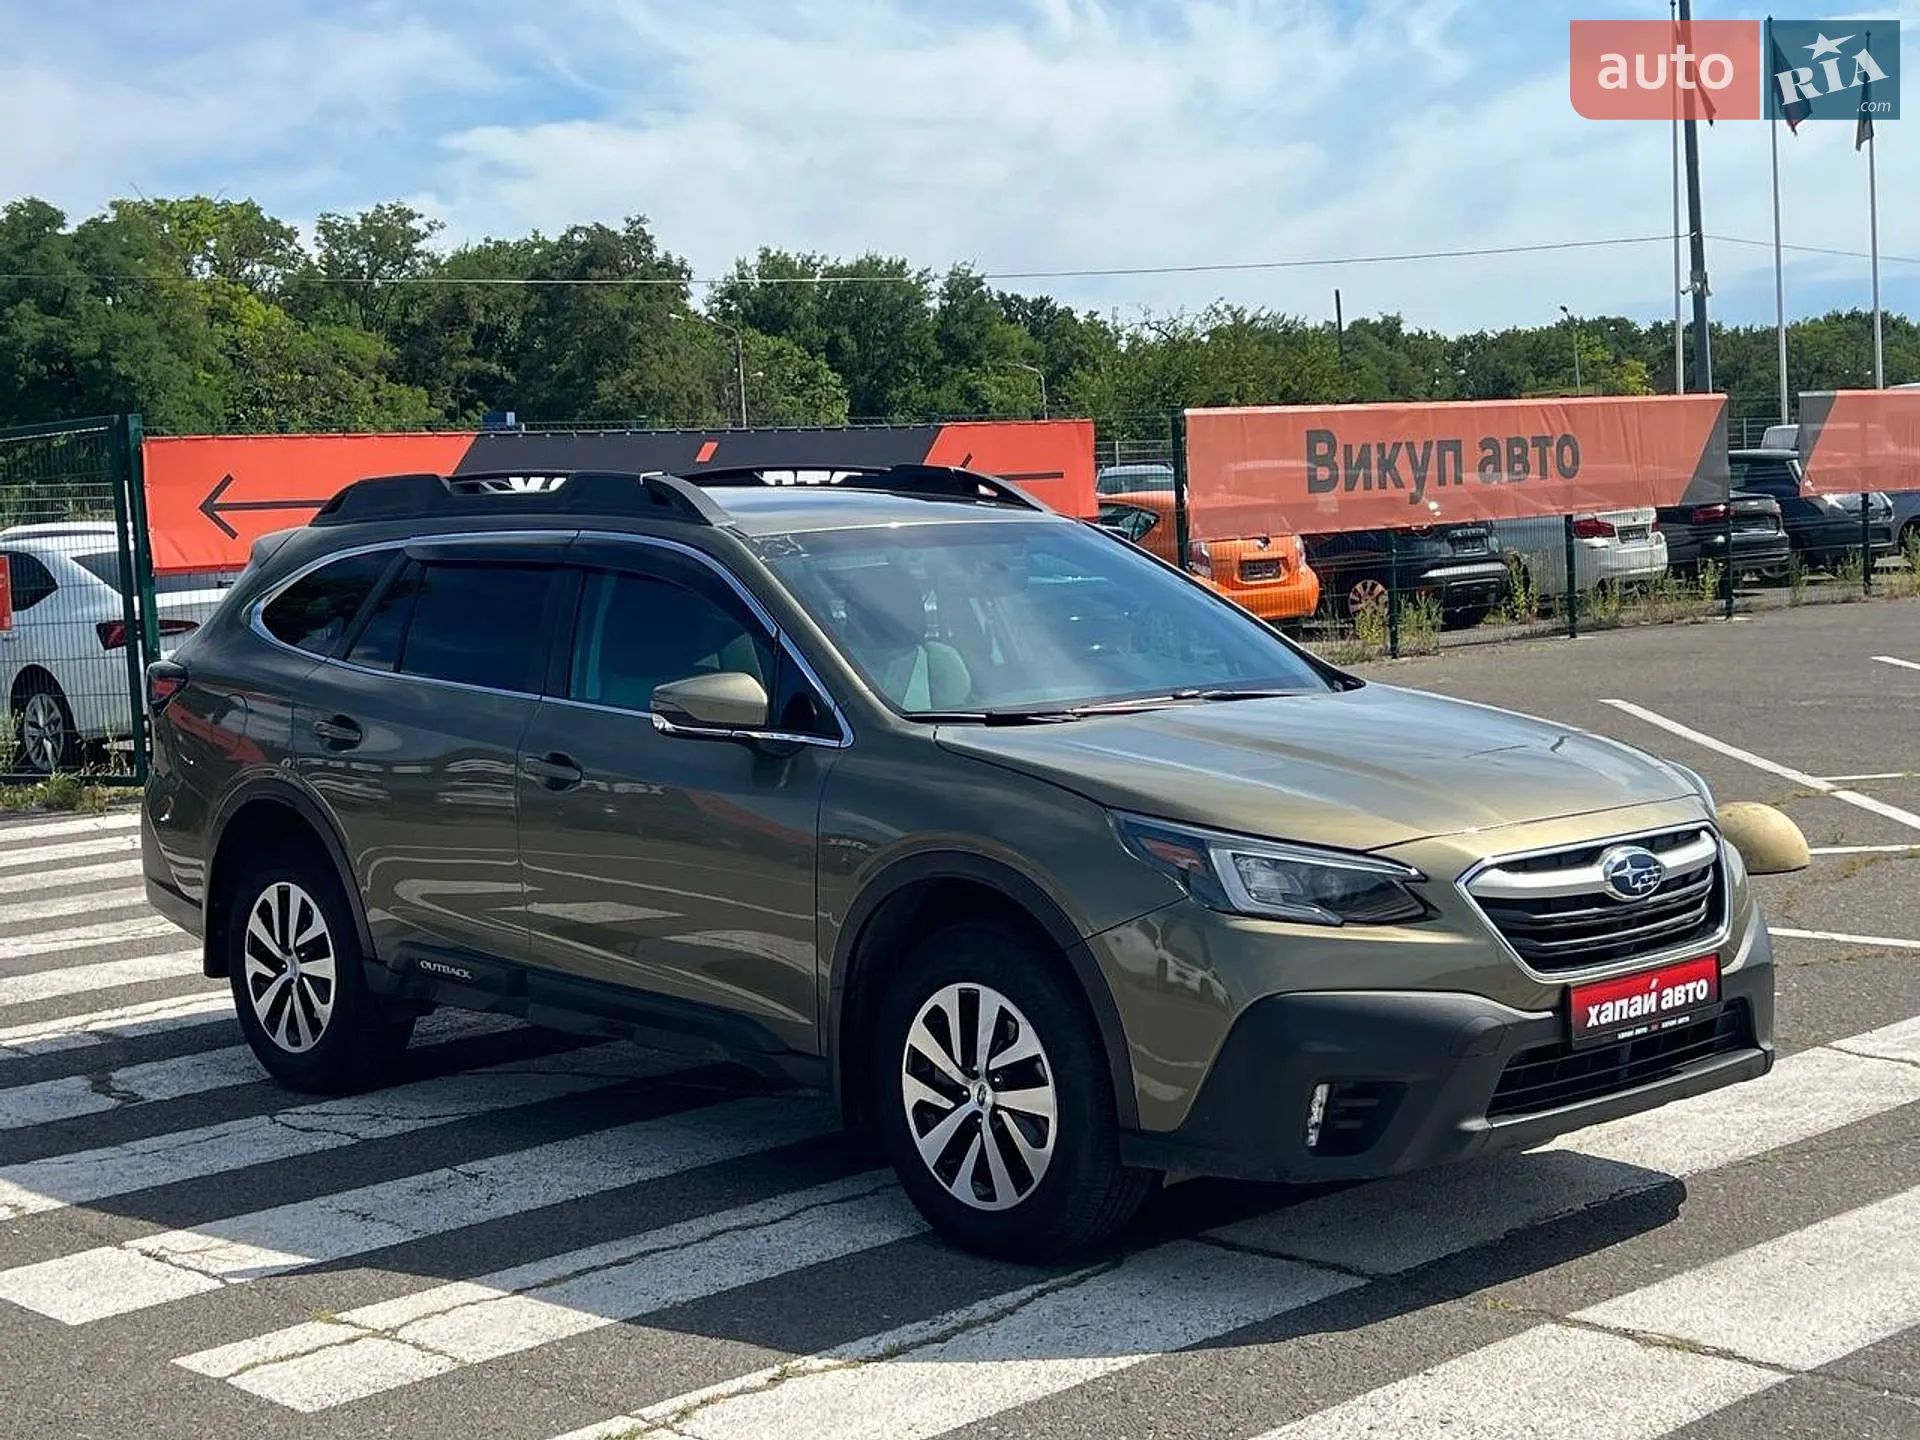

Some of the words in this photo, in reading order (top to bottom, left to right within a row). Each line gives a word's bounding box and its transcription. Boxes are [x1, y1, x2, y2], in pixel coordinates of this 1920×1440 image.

[1305, 429, 1462, 504] Викуп
[1477, 432, 1580, 485] авто
[420, 960, 472, 980] OUTBACK
[1661, 978, 1708, 1009] авто
